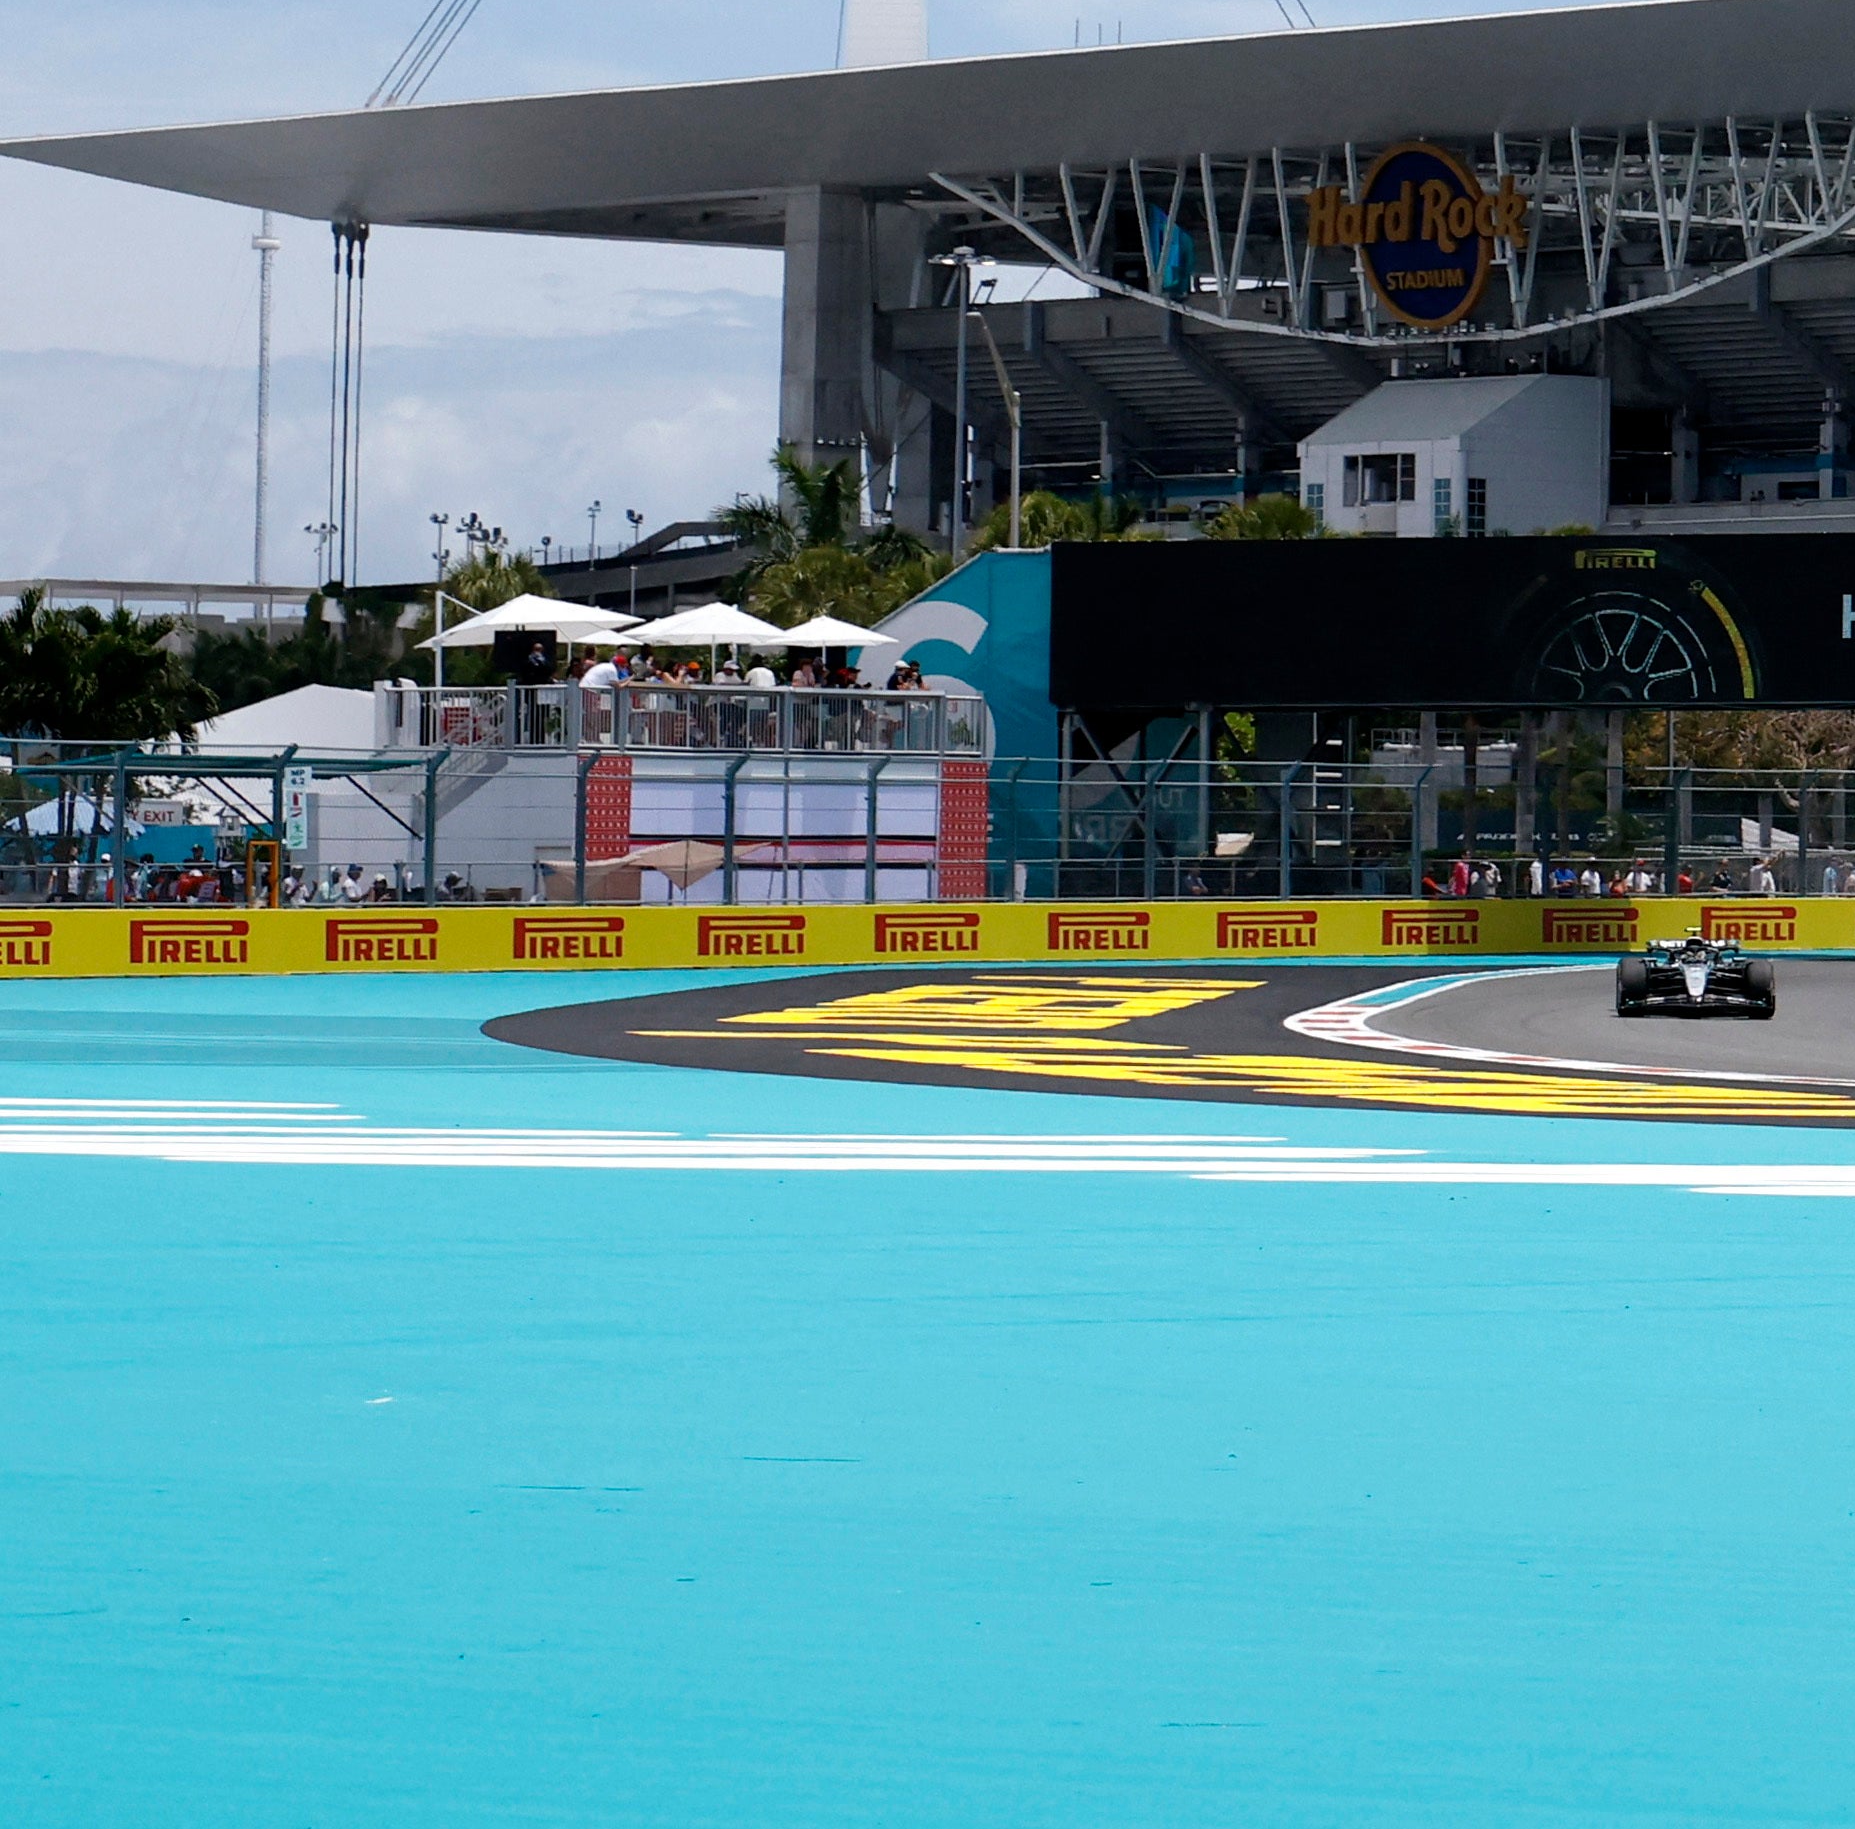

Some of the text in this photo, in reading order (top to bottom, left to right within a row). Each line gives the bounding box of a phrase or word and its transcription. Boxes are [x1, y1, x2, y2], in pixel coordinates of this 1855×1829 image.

[1305, 175, 1528, 254] Hard Rock
[1386, 268, 1466, 291] STADIUM
[1574, 547, 1657, 570] PIRELLI
[143, 811, 174, 822] EXIT
[131, 921, 248, 962] PIRELLI
[327, 919, 438, 960] PIRELLI
[514, 918, 624, 958] PIRELLI
[698, 916, 805, 955] PIRELLI
[875, 914, 979, 952] PIRELLI
[1049, 913, 1149, 949] PIRELLI
[1217, 911, 1317, 947] PIRELLI
[1383, 909, 1479, 945] PIRELLI
[1543, 907, 1639, 942] PIRELLI
[1702, 906, 1796, 941] PIRELLI
